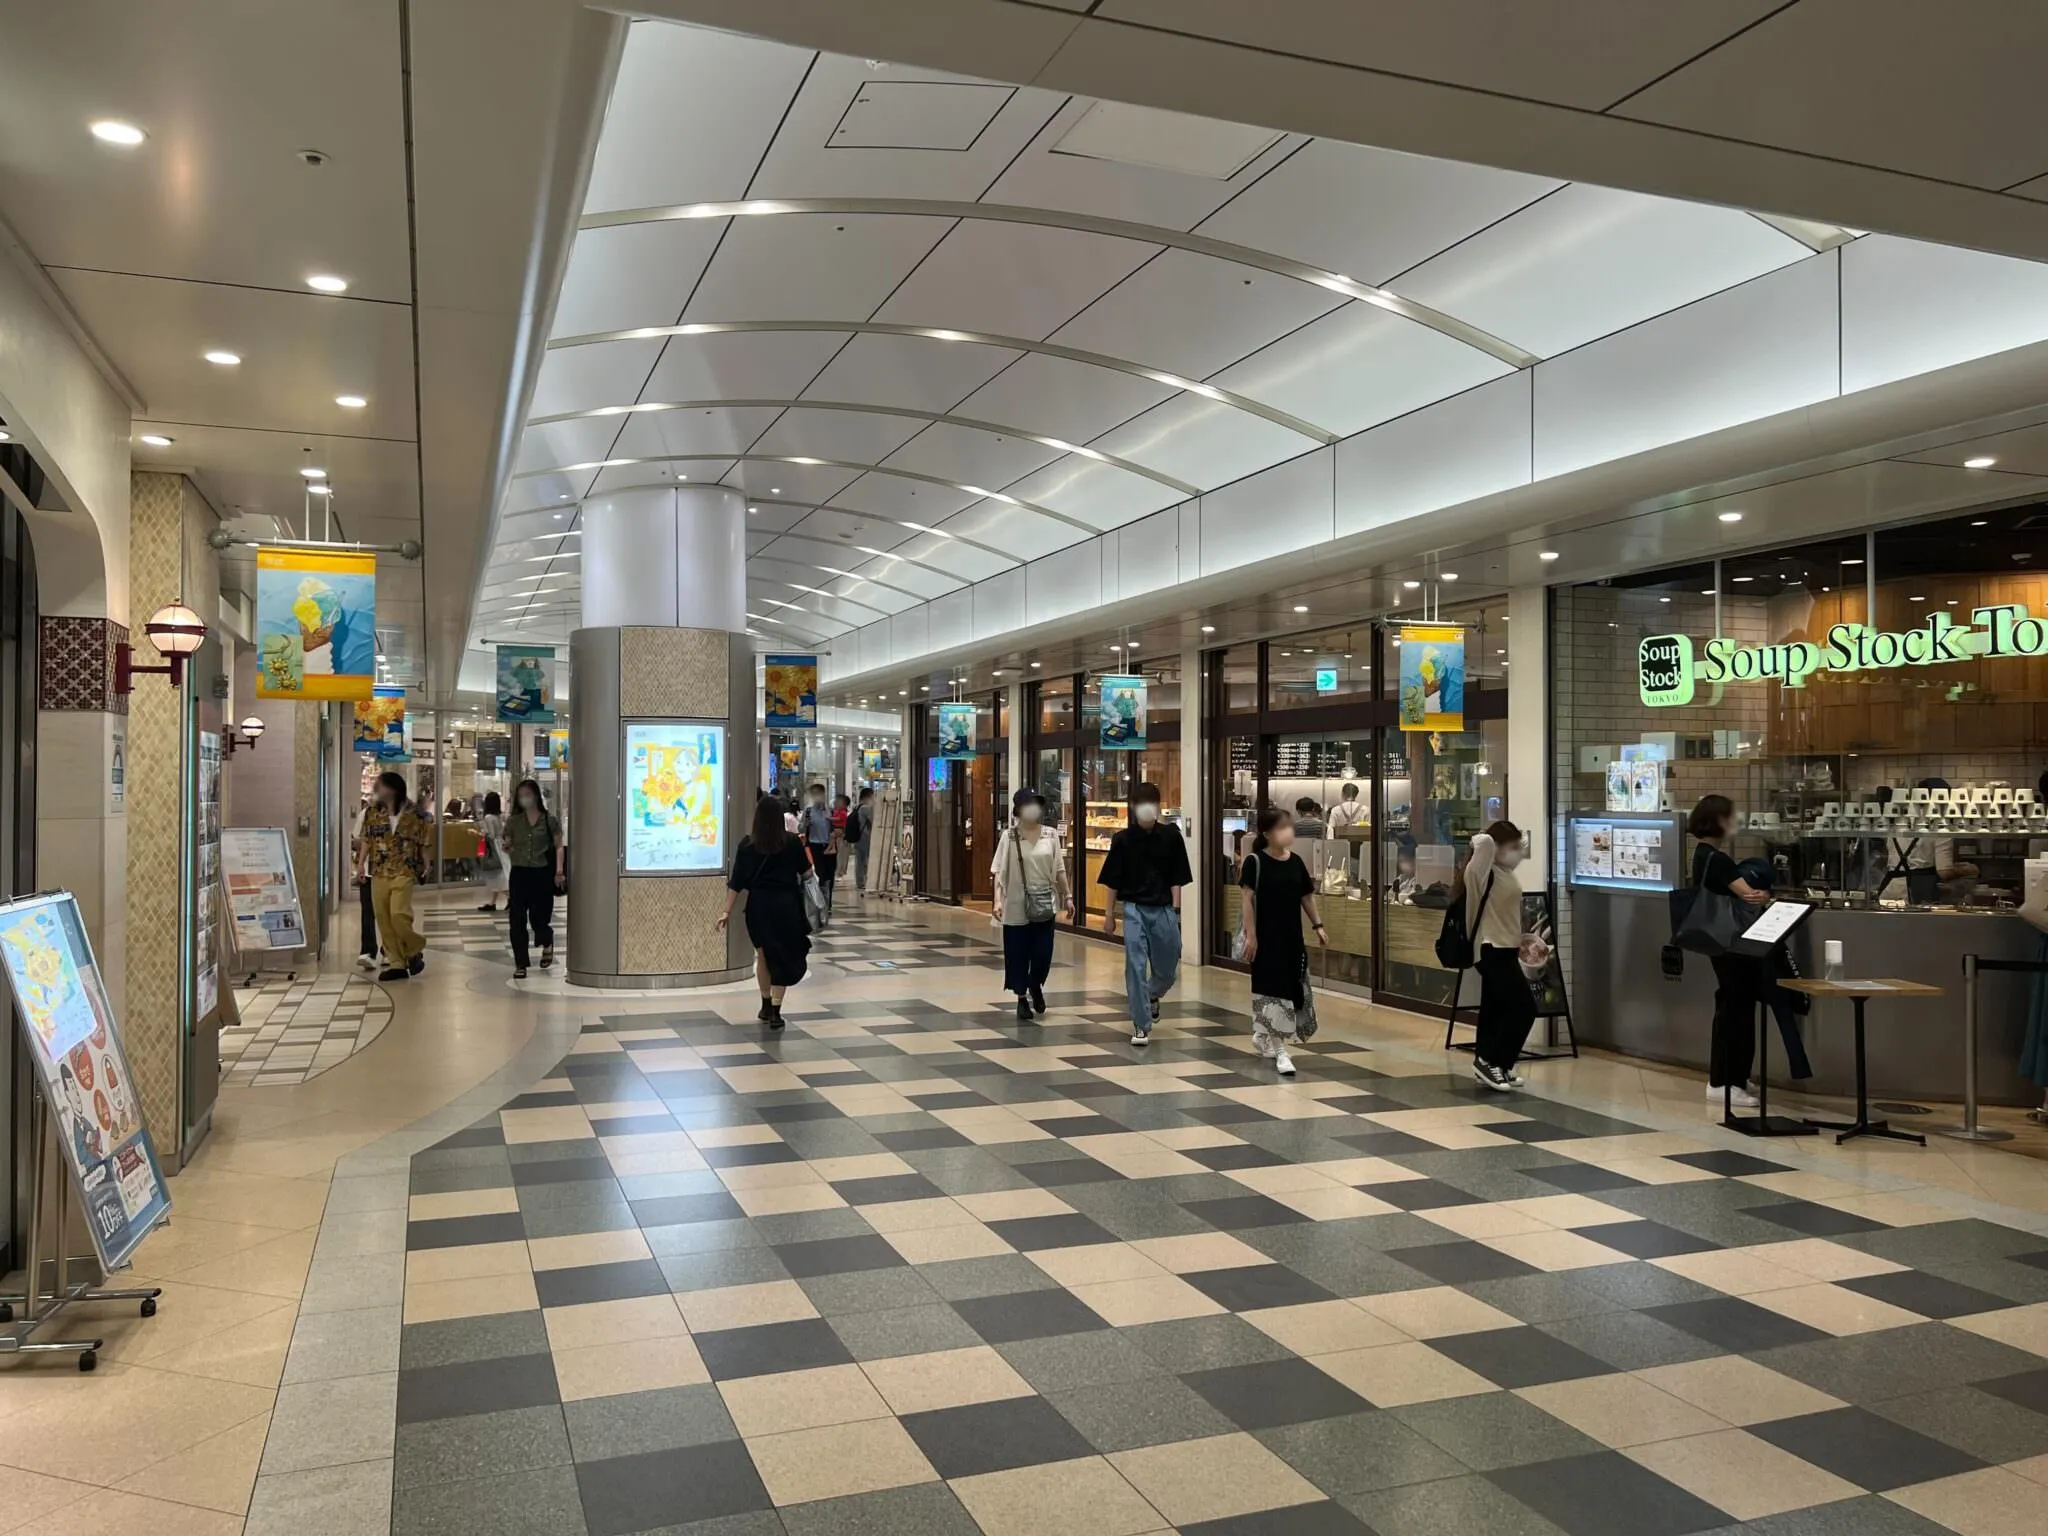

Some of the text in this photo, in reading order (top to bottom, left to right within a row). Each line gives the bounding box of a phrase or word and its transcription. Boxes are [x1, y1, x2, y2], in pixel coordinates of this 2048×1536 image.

[1640, 643, 1681, 665] Soup
[1704, 606, 2045, 687] Soup Stock To
[1640, 666, 1682, 689] Stock
